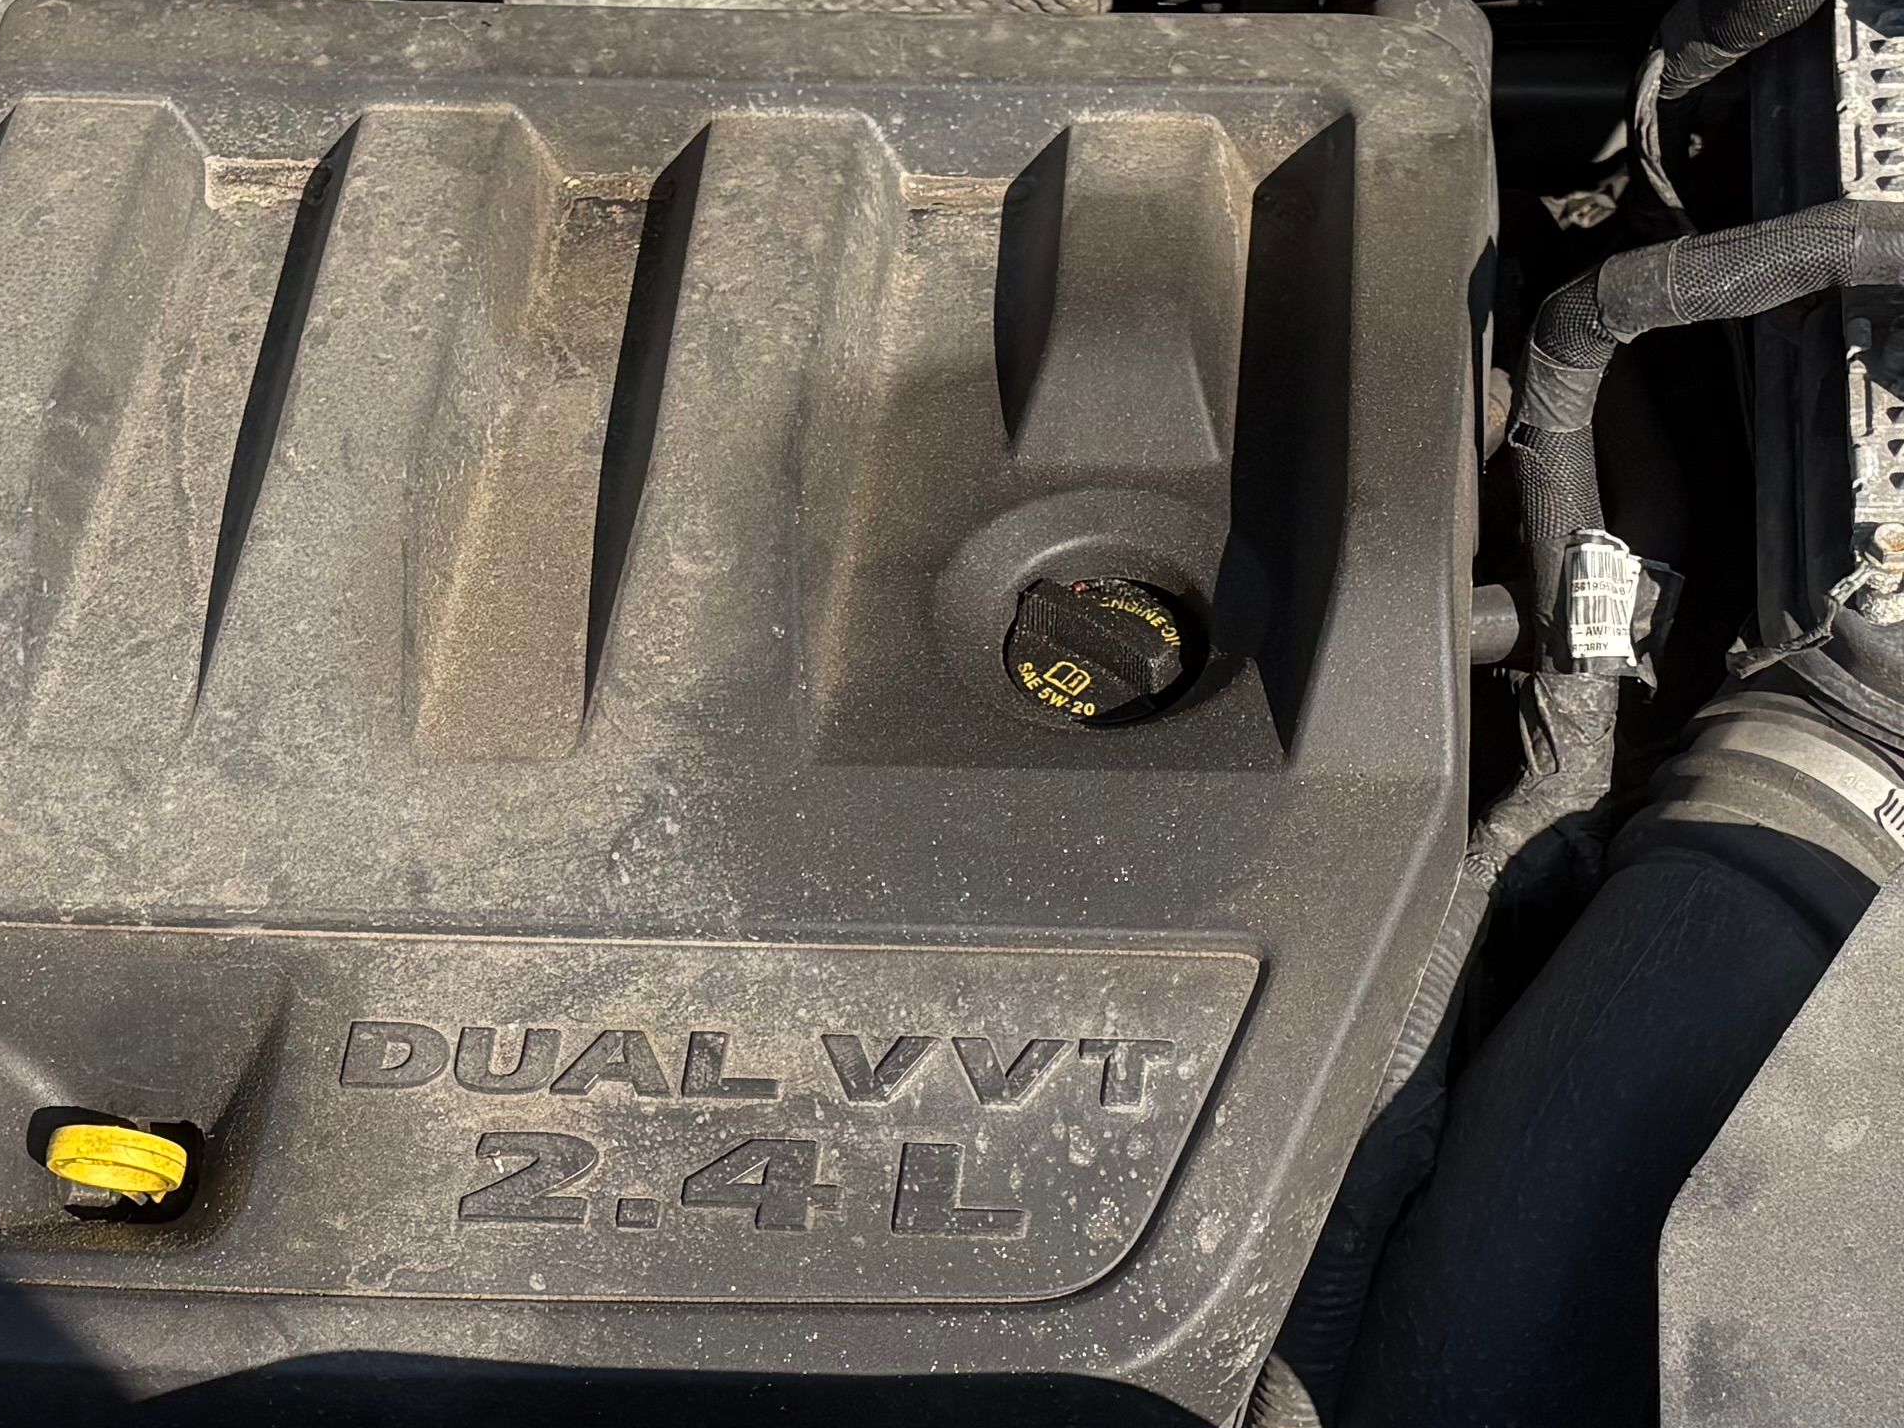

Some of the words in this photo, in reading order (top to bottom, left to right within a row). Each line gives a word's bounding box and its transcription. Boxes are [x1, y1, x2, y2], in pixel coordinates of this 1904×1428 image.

[1017, 661, 1044, 691] SAE
[1037, 686, 1097, 717] 5W-20
[339, 1020, 780, 1101] DUAL
[820, 1032, 1175, 1110] VVT
